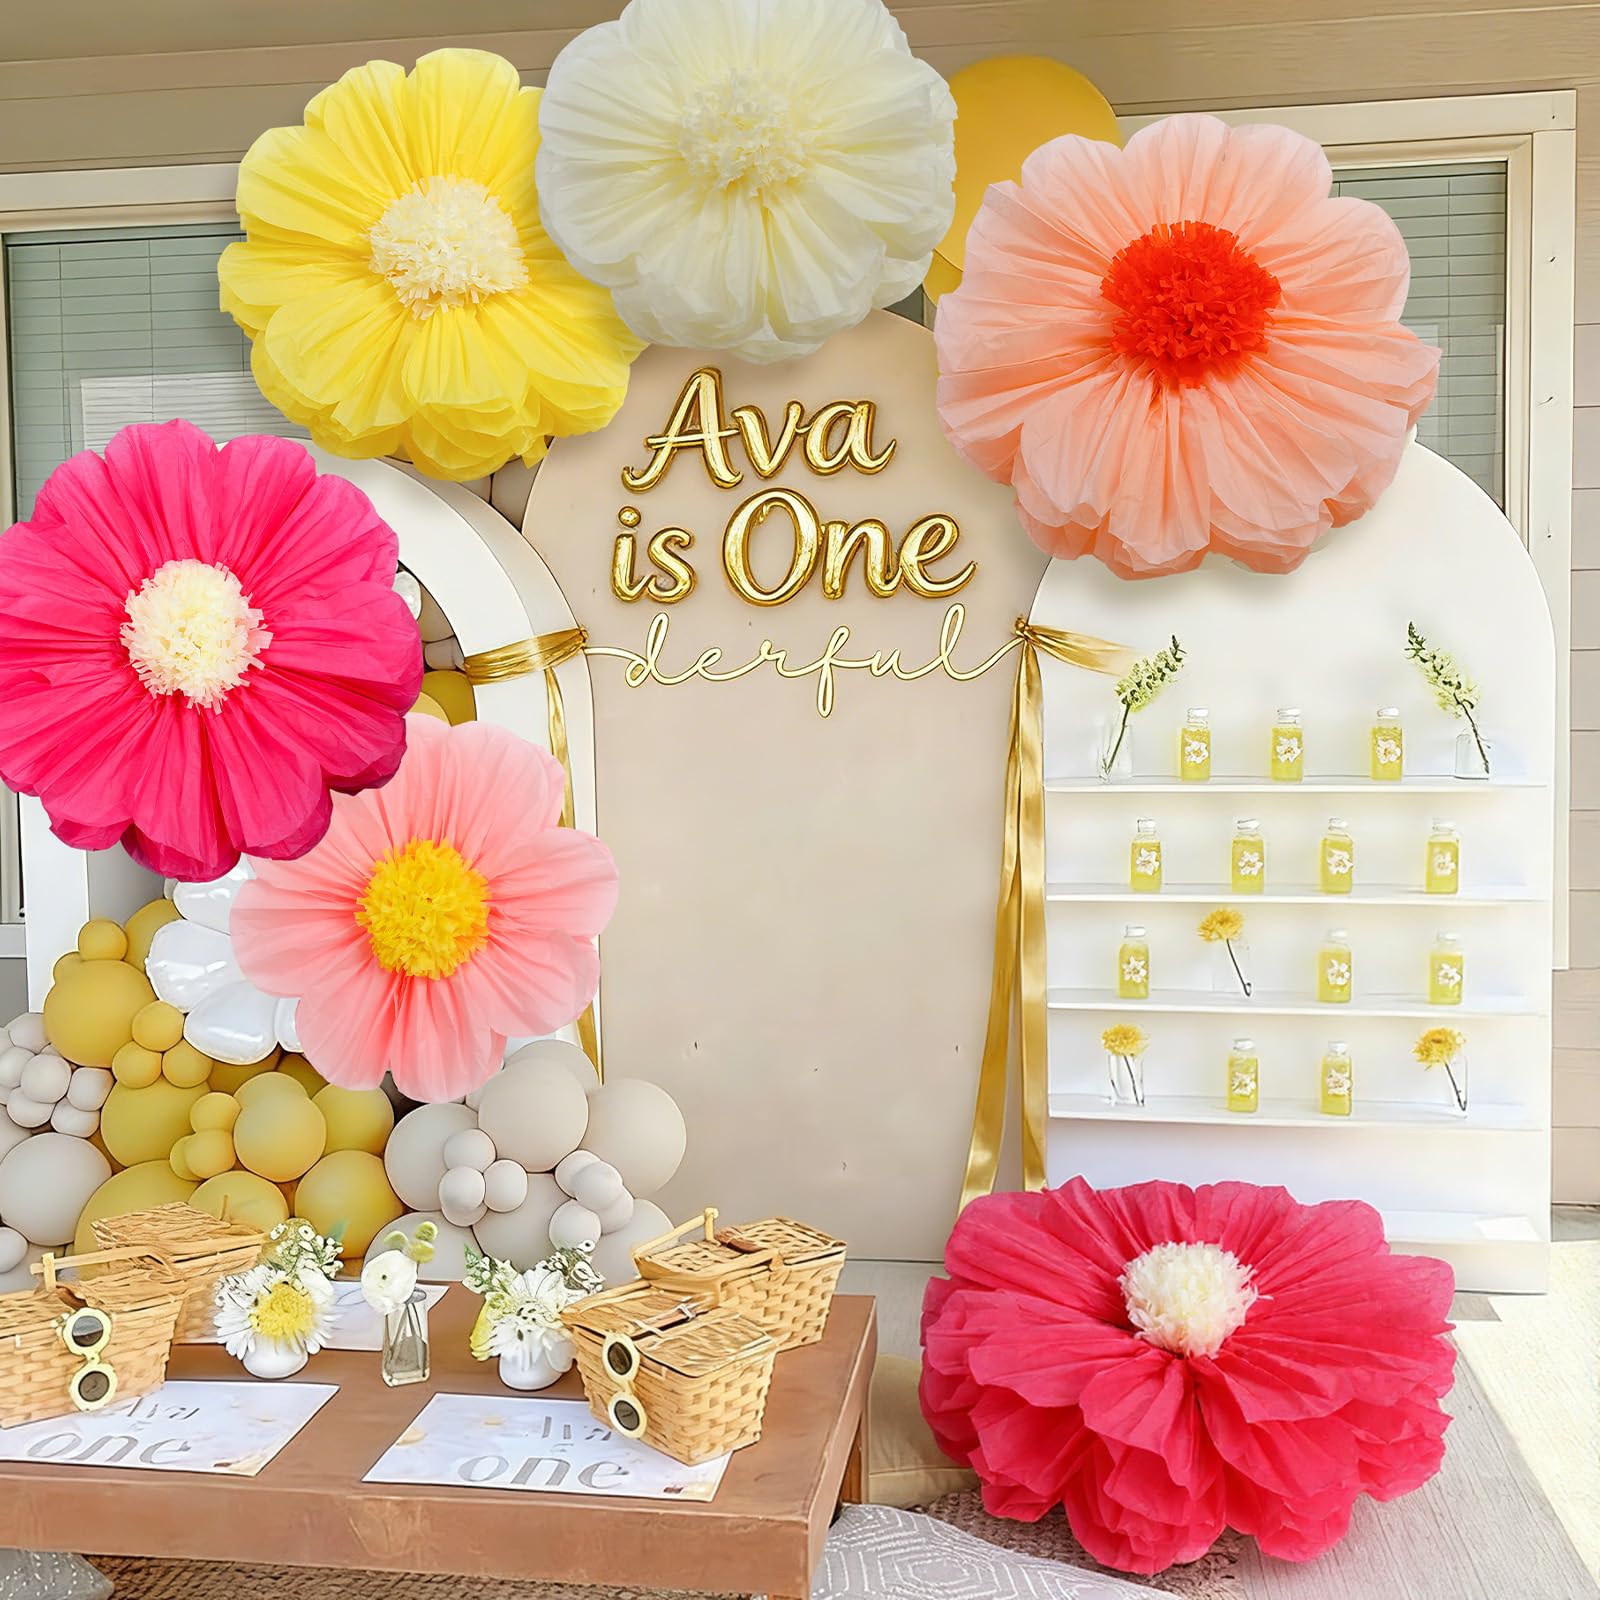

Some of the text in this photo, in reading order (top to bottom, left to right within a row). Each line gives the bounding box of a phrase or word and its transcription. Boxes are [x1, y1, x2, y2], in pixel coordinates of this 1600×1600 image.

[621, 366, 897, 492] Ava
[610, 487, 978, 608] is One
[588, 603, 1020, 718] derful
[26, 1432, 192, 1465] one
[456, 1454, 629, 1490] one
